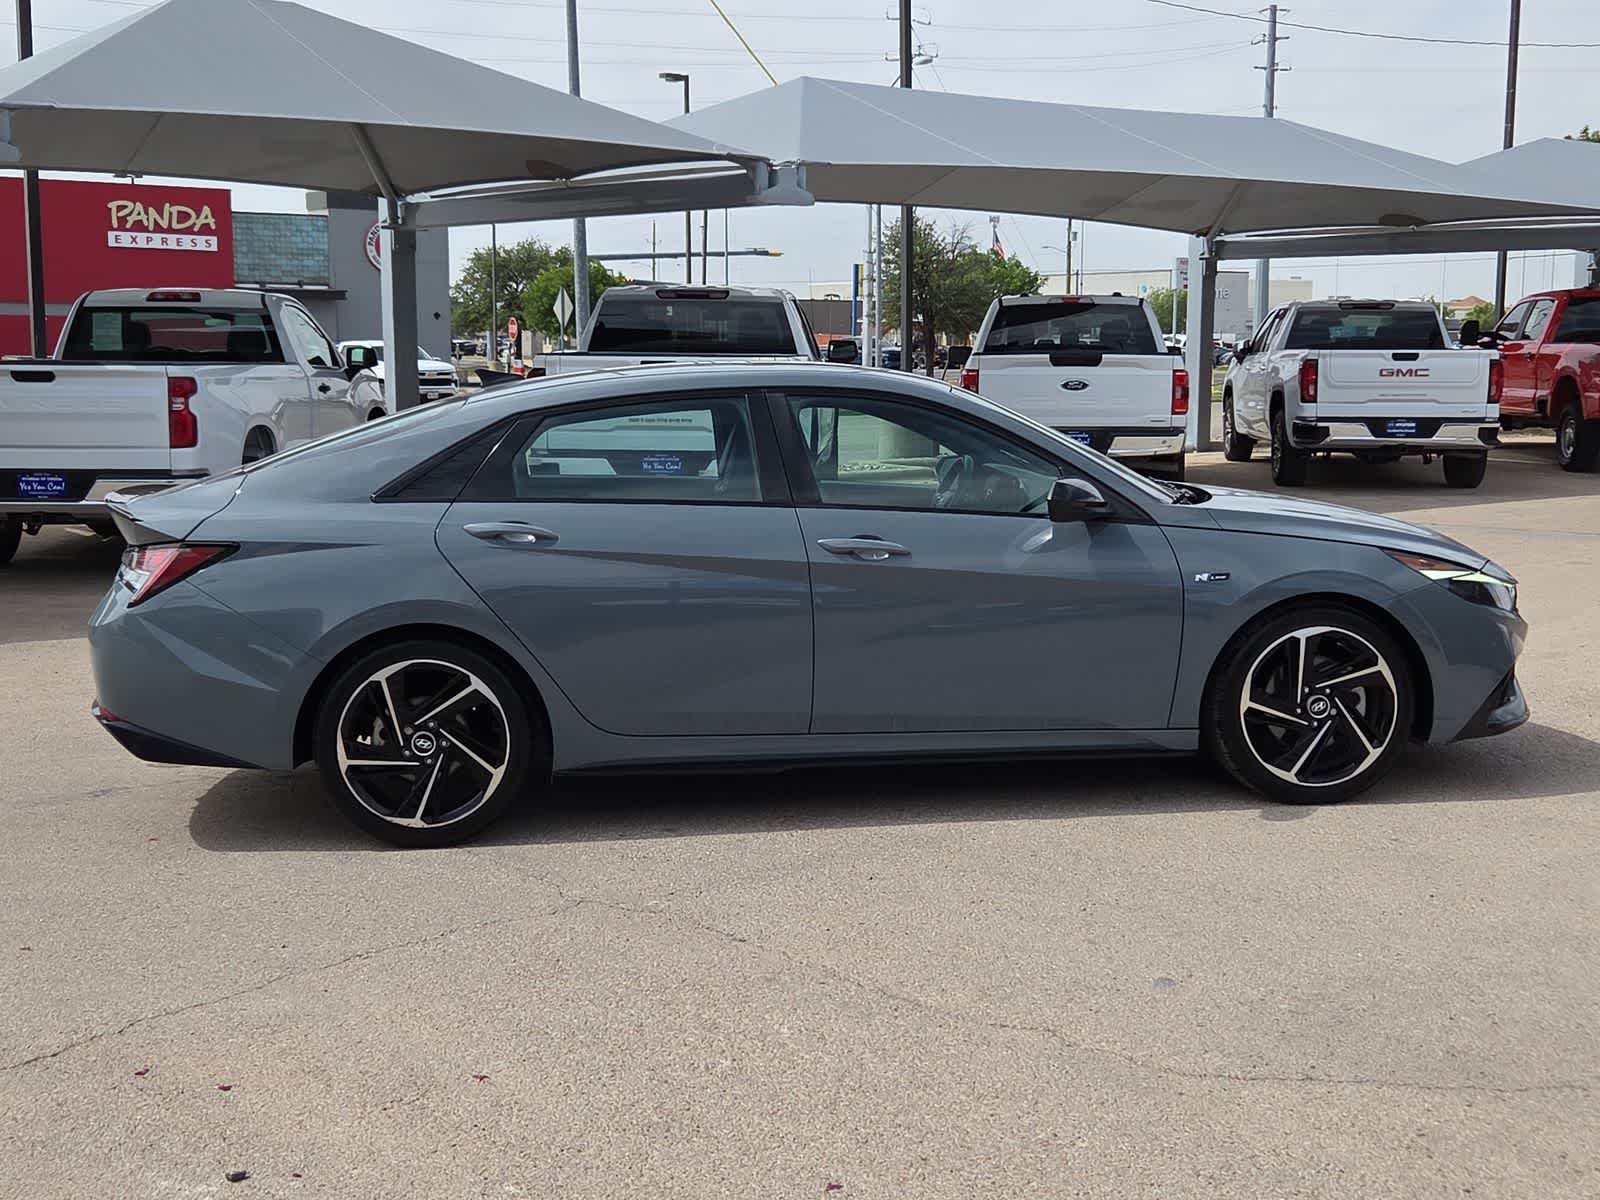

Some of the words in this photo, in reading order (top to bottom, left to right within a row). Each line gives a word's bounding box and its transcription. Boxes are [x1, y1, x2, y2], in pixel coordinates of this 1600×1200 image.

[107, 200, 216, 232] PANDA
[114, 234, 212, 248] EXPRESS
[1379, 368, 1430, 377] GMC
